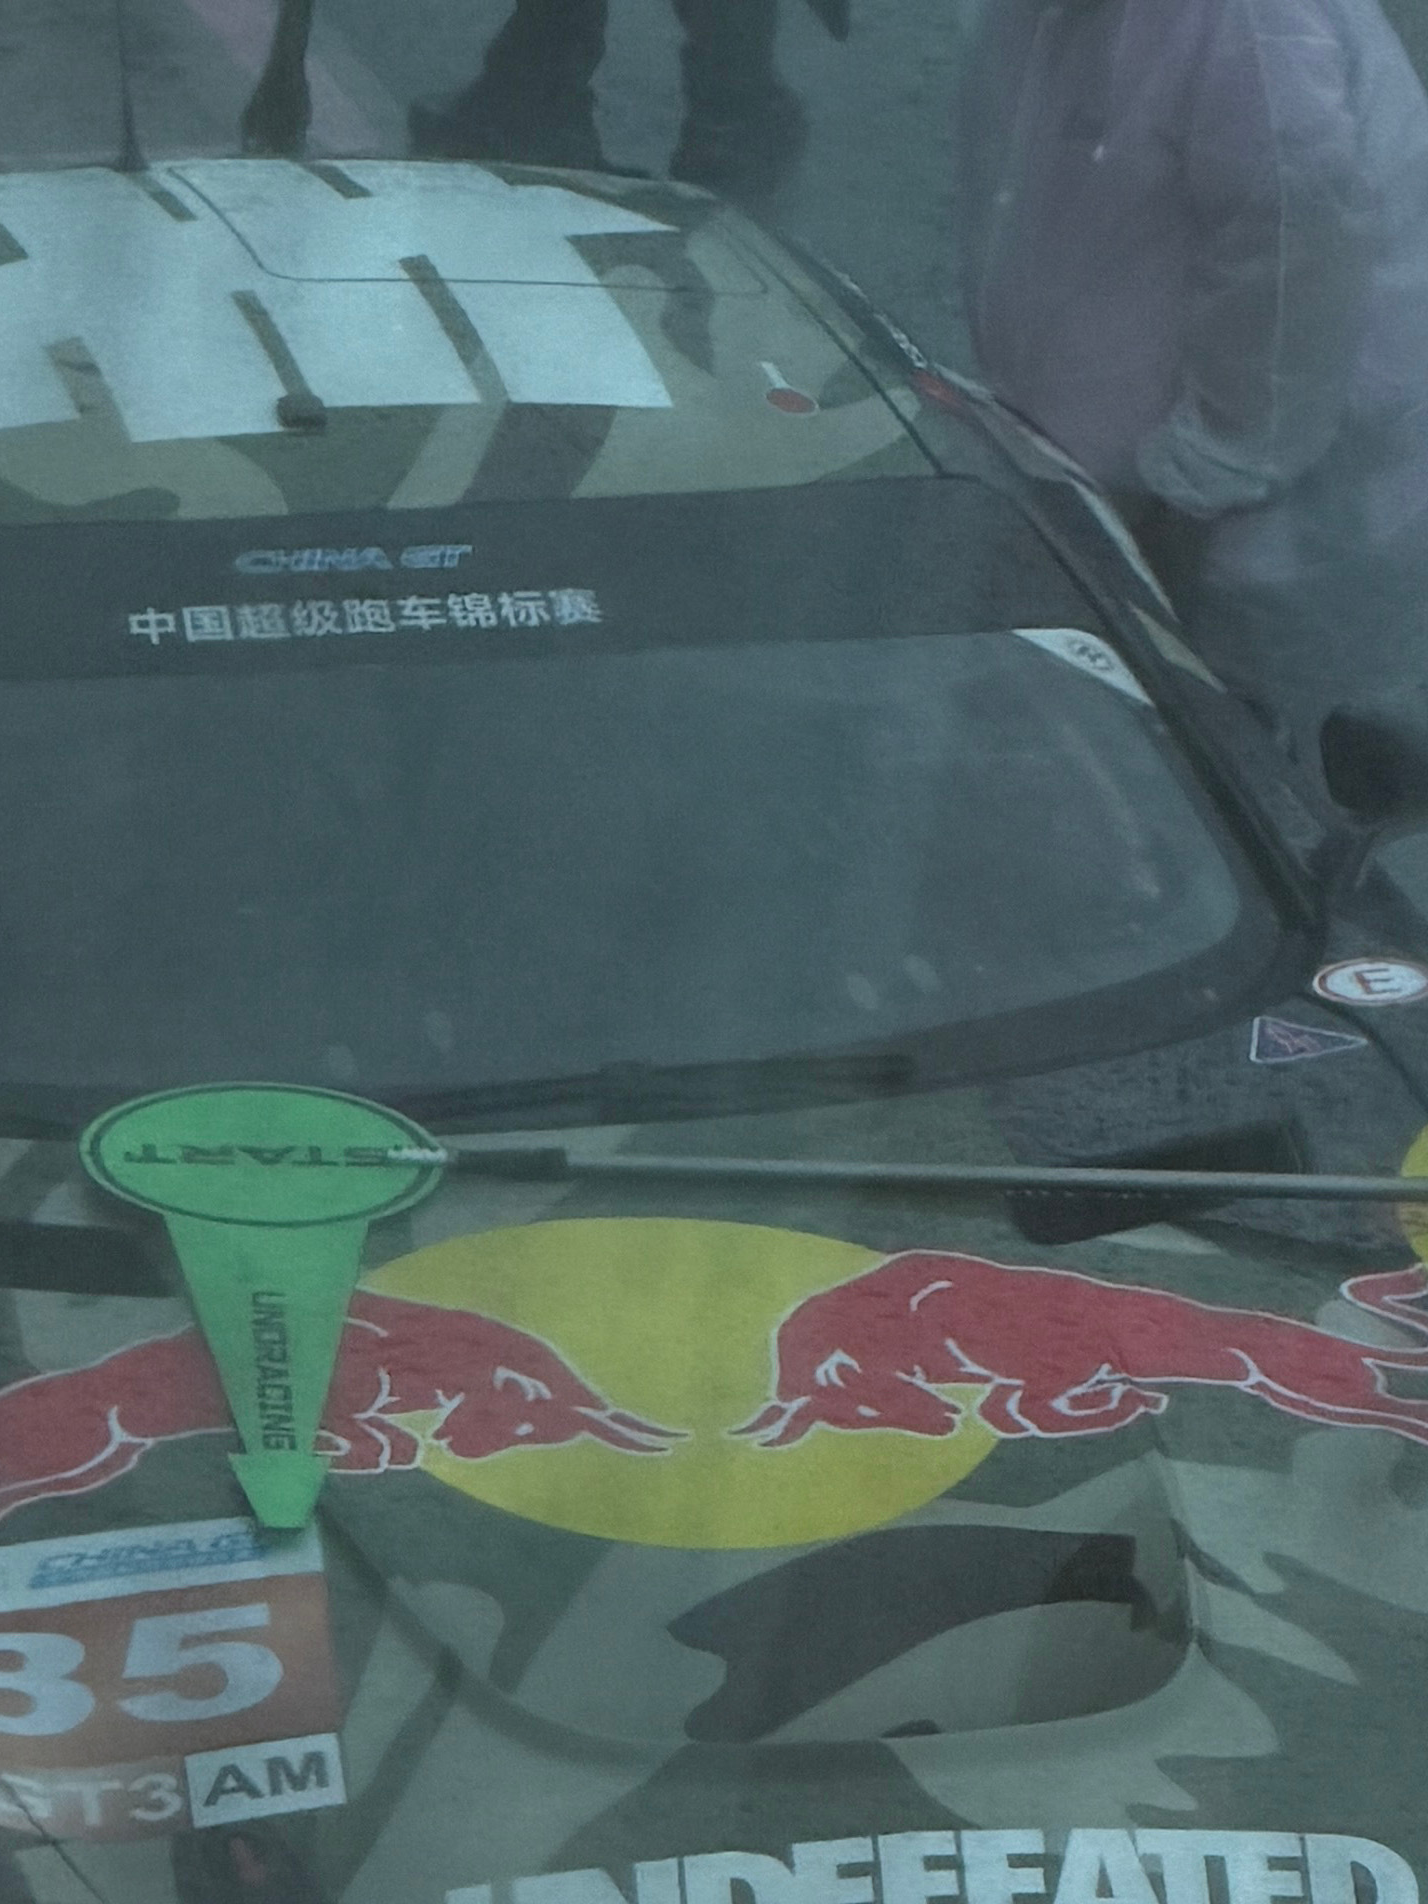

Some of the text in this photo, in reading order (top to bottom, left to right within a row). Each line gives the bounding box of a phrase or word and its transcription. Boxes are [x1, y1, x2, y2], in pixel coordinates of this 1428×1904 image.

[233, 543, 474, 575] CHINA GT
[128, 589, 603, 645] 中国超级跑车锦标赛
[1353, 968, 1402, 995] E
[123, 1143, 388, 1166] START
[251, 1291, 298, 1451] UNORACING
[203, 1751, 329, 1807] AM
